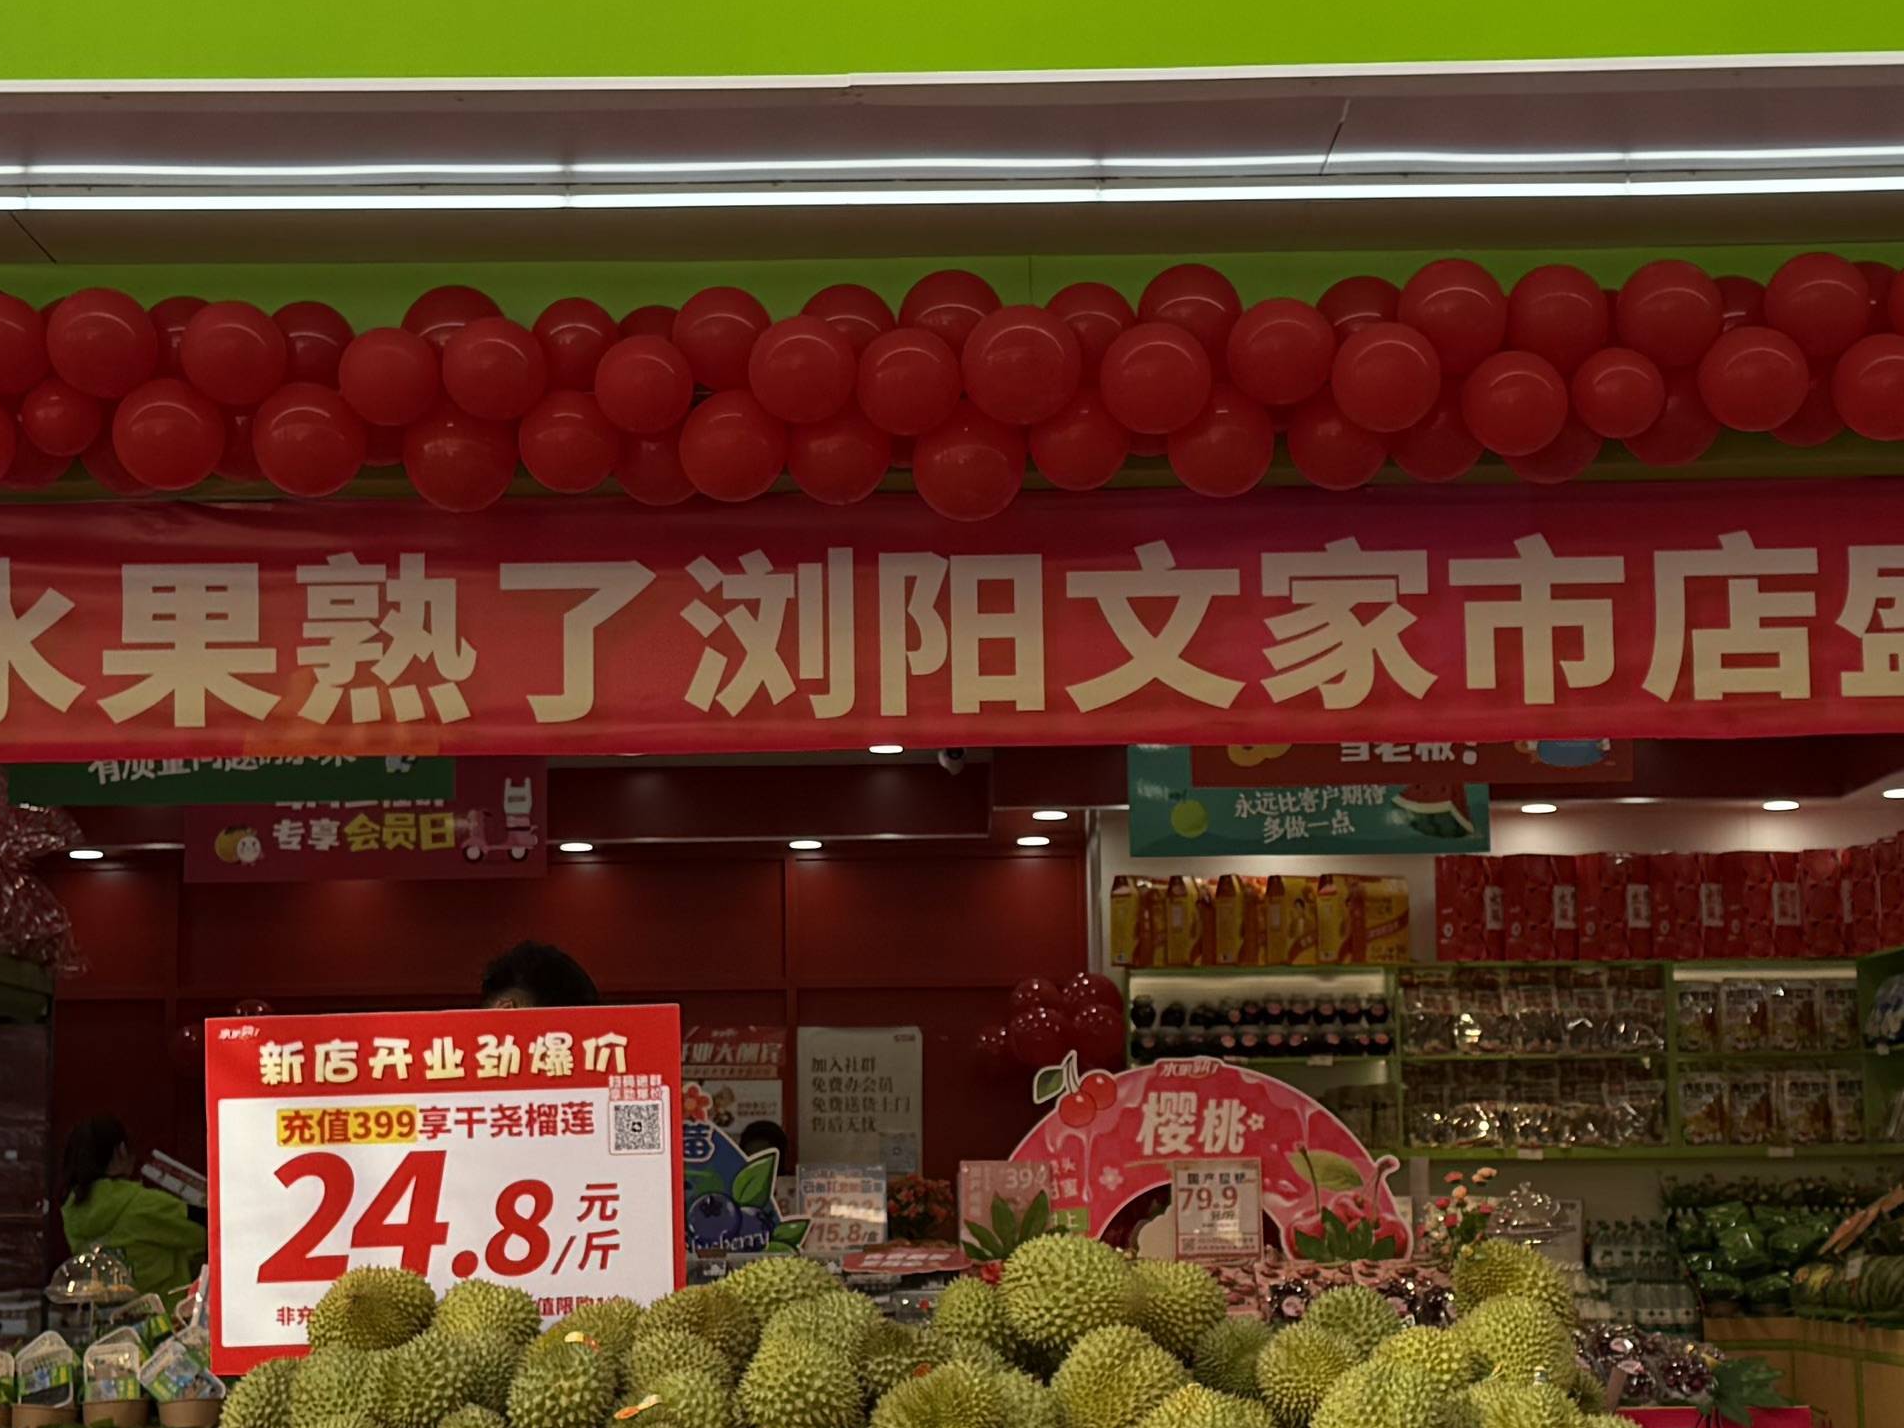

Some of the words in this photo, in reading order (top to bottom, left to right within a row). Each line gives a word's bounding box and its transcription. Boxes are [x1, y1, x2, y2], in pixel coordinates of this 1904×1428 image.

[1234, 784, 1388, 819] 永远比客户期待
[272, 812, 456, 852] 专享会员日
[1262, 809, 1355, 844] 多做一点
[258, 1031, 630, 1086] 新店开业劲爆价
[811, 1056, 876, 1073] 加入社群
[811, 1076, 894, 1094] 免费办会员
[811, 1096, 912, 1114] 免费送货上门
[281, 1101, 596, 1145] 充值399享干尧榴莲
[1136, 1091, 1248, 1156] 樱桃
[256, 1150, 554, 1285] 24.8
[576, 1183, 621, 1223] 元
[1178, 1186, 1238, 1211] 79.9
[552, 1229, 621, 1275] /斤
